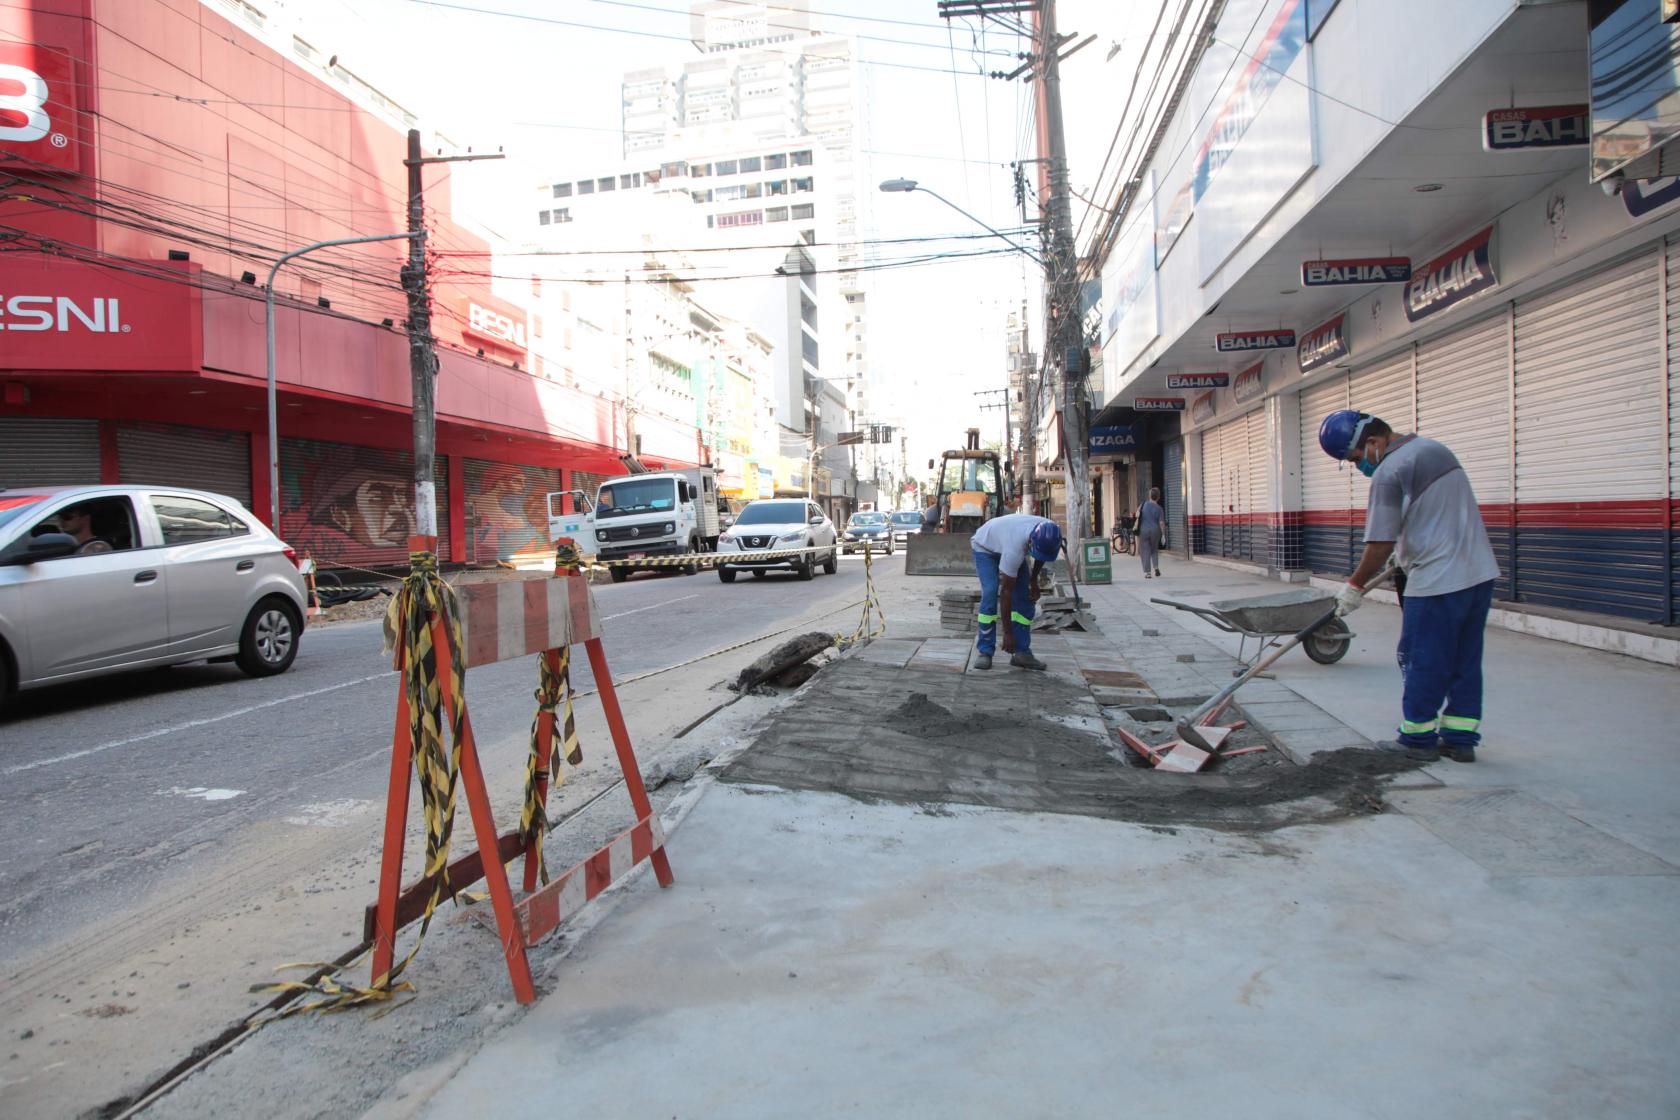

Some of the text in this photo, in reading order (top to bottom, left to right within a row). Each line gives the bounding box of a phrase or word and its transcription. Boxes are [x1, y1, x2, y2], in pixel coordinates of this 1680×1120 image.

[1492, 111, 1526, 122] CASAS
[1307, 265, 1387, 283] BAHIA
[1409, 249, 1484, 313] BAHIA
[0, 295, 119, 333] SNI
[1221, 335, 1279, 350] BAHIA
[1169, 377, 1215, 388] BAHIA
[1136, 400, 1174, 409] BAHIA
